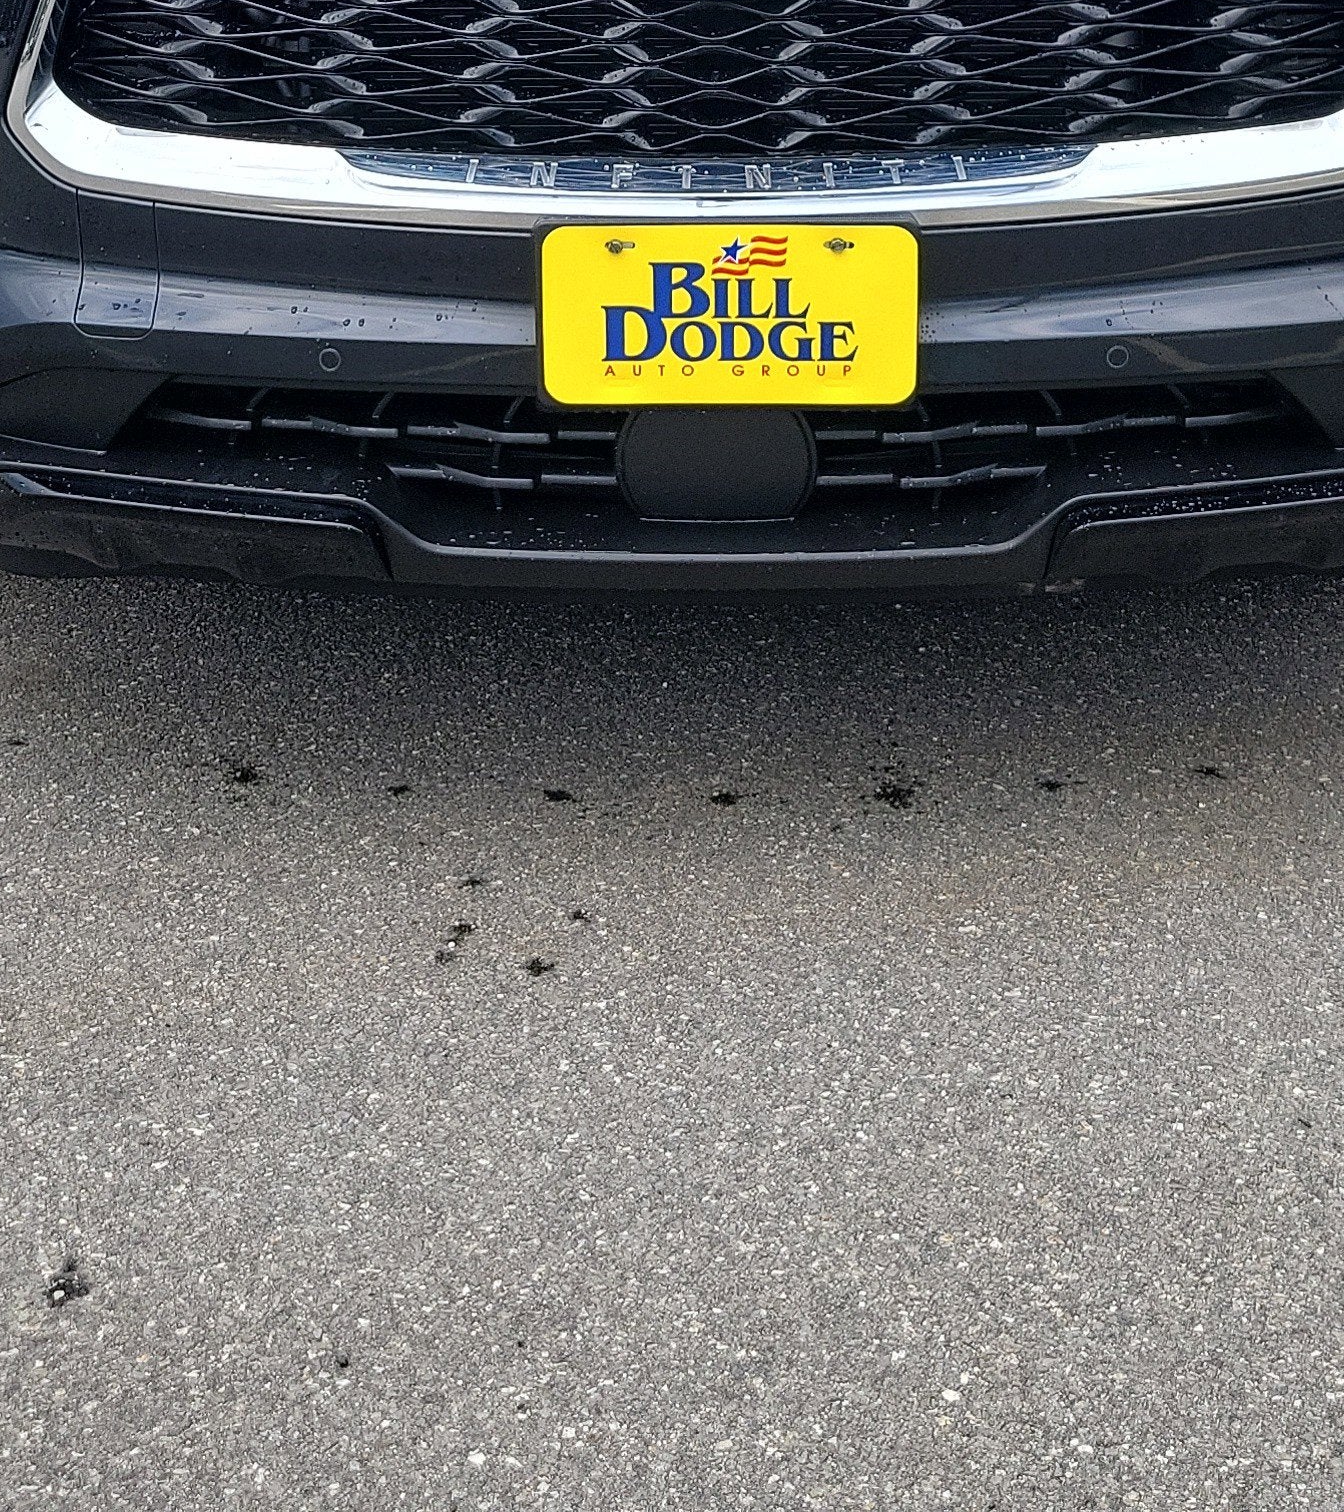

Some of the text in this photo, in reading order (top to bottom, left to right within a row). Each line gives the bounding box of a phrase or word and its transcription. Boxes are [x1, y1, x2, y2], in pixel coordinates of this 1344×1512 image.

[464, 155, 968, 189] INFINITI
[648, 261, 811, 319] BILL
[600, 305, 860, 362] DODGE
[603, 364, 853, 377] AUTO GROUP
